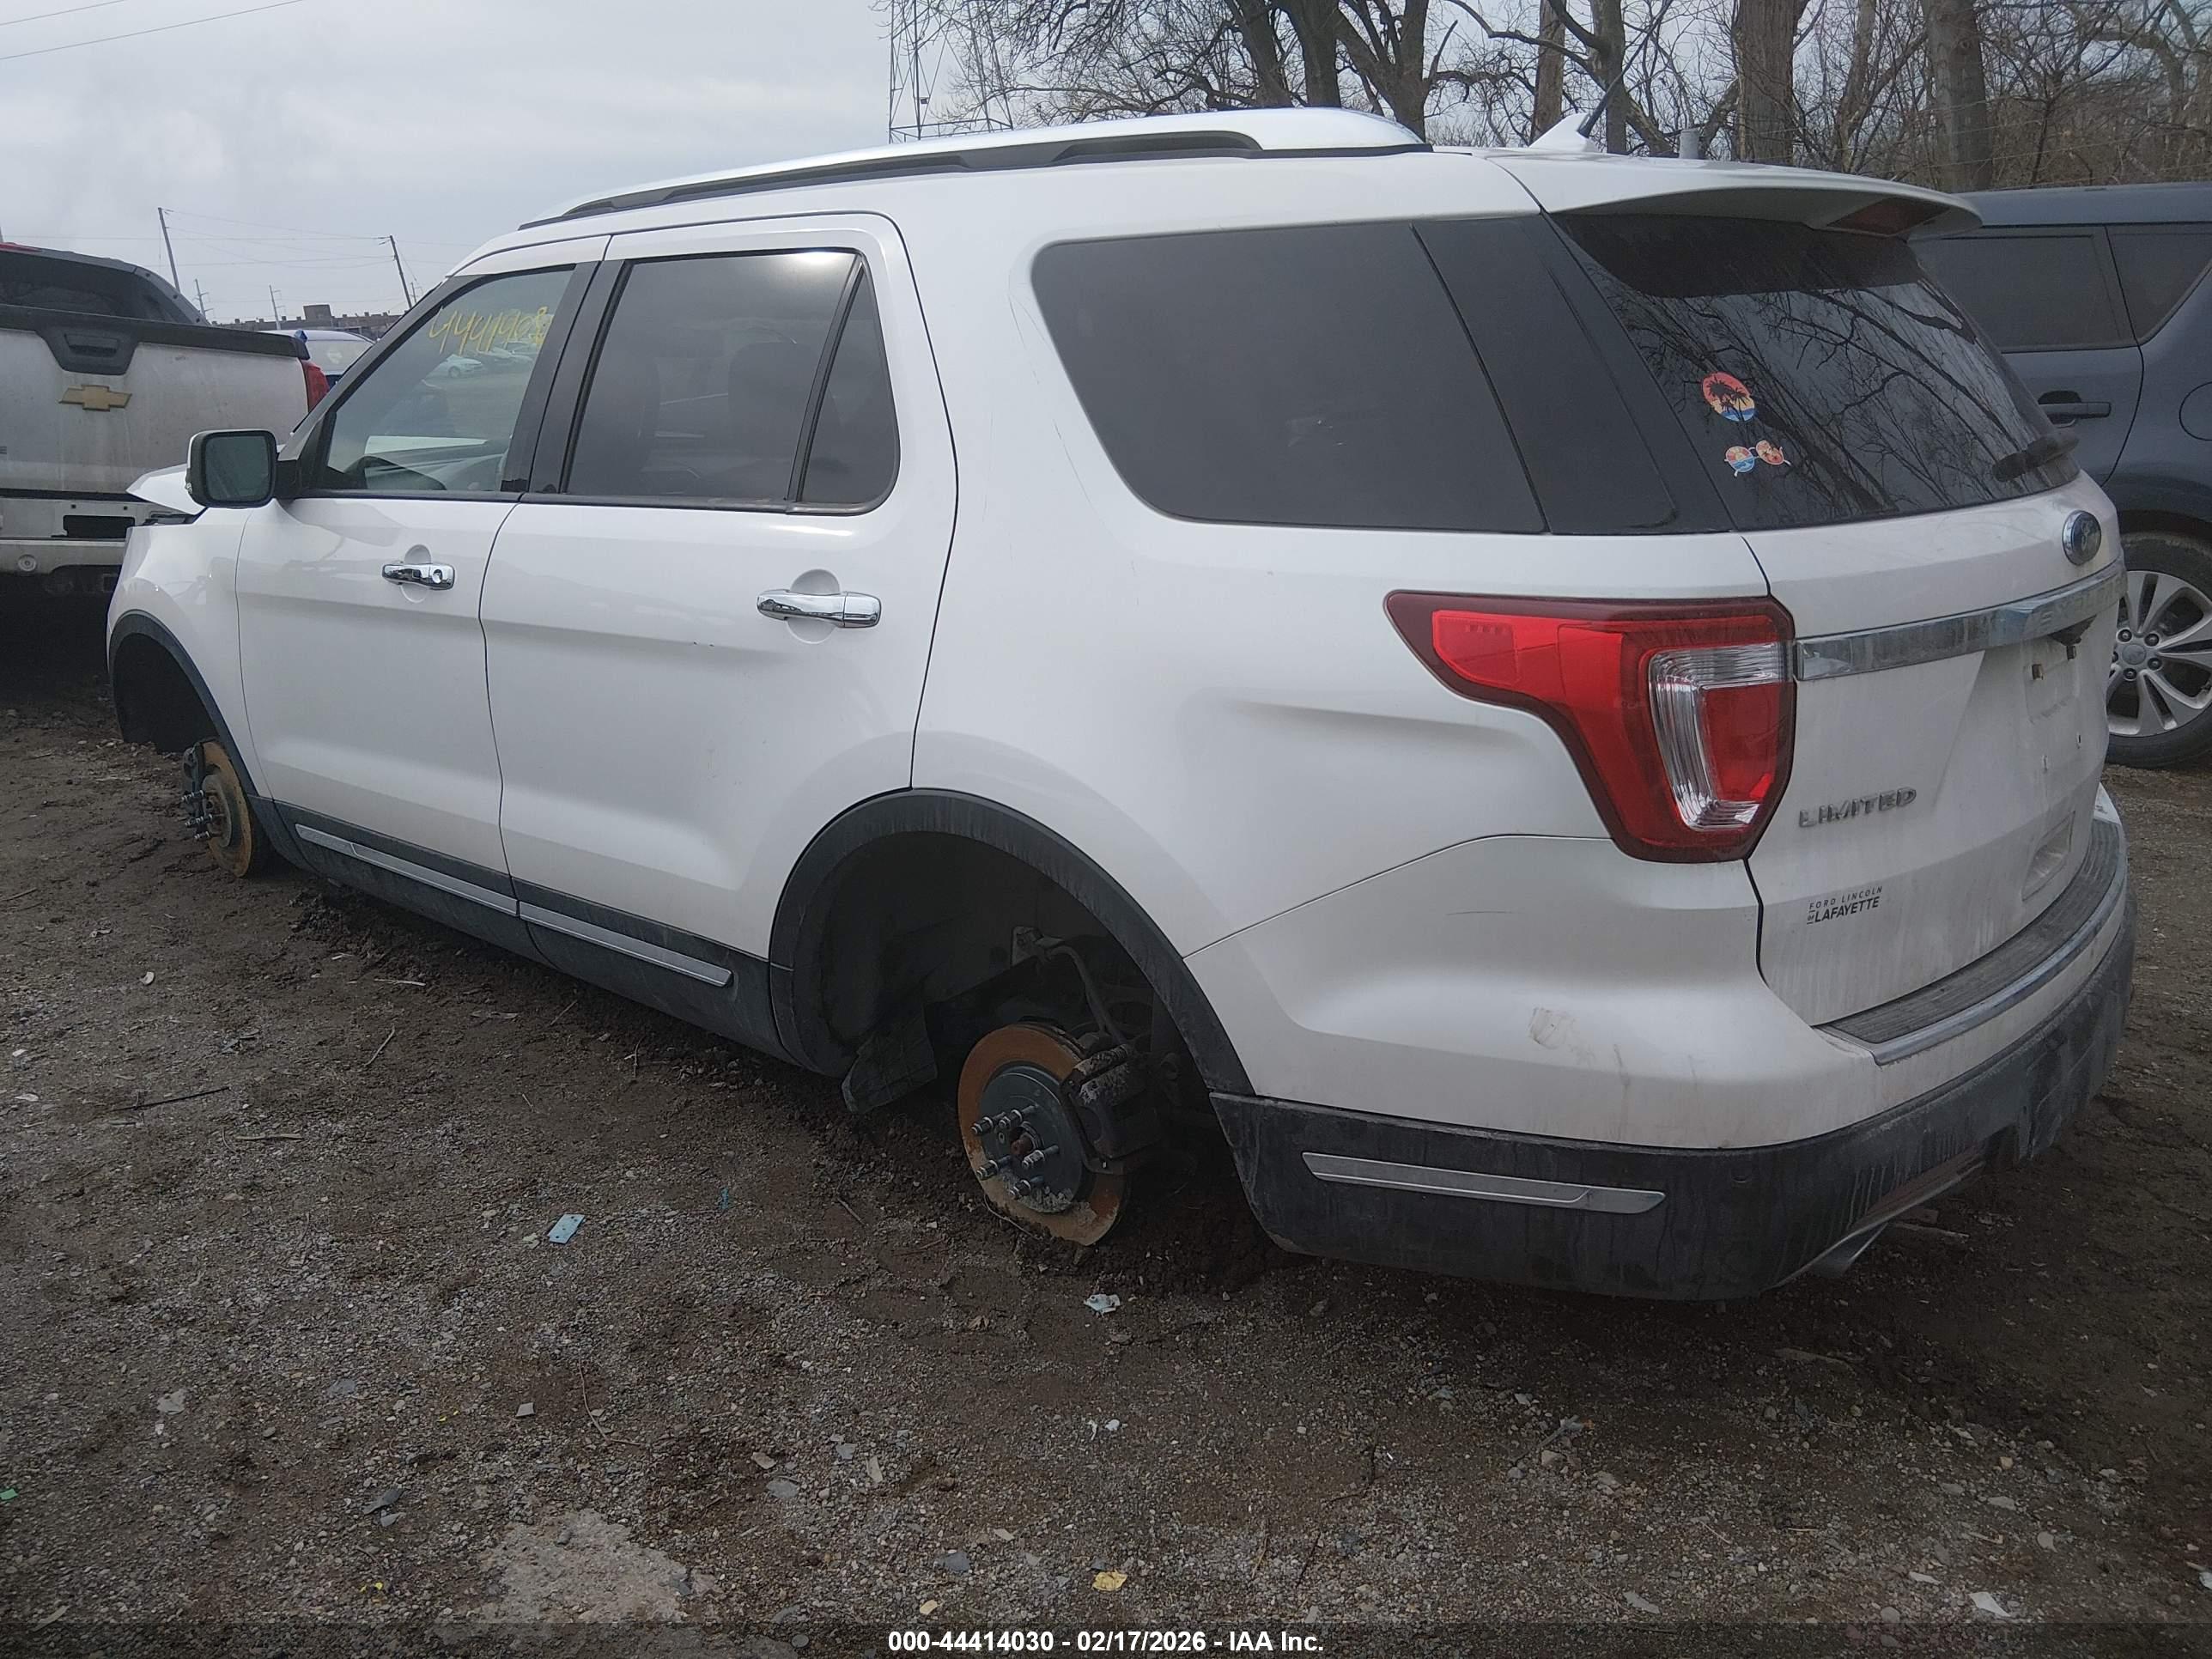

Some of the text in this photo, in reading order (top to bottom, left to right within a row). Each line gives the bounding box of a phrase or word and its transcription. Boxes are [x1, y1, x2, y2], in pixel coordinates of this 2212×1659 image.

[1799, 787, 1917, 828] LIMITED
[1809, 886, 1882, 910] FORD LINCOLN
[1814, 896, 1881, 923] LAFAYETTE
